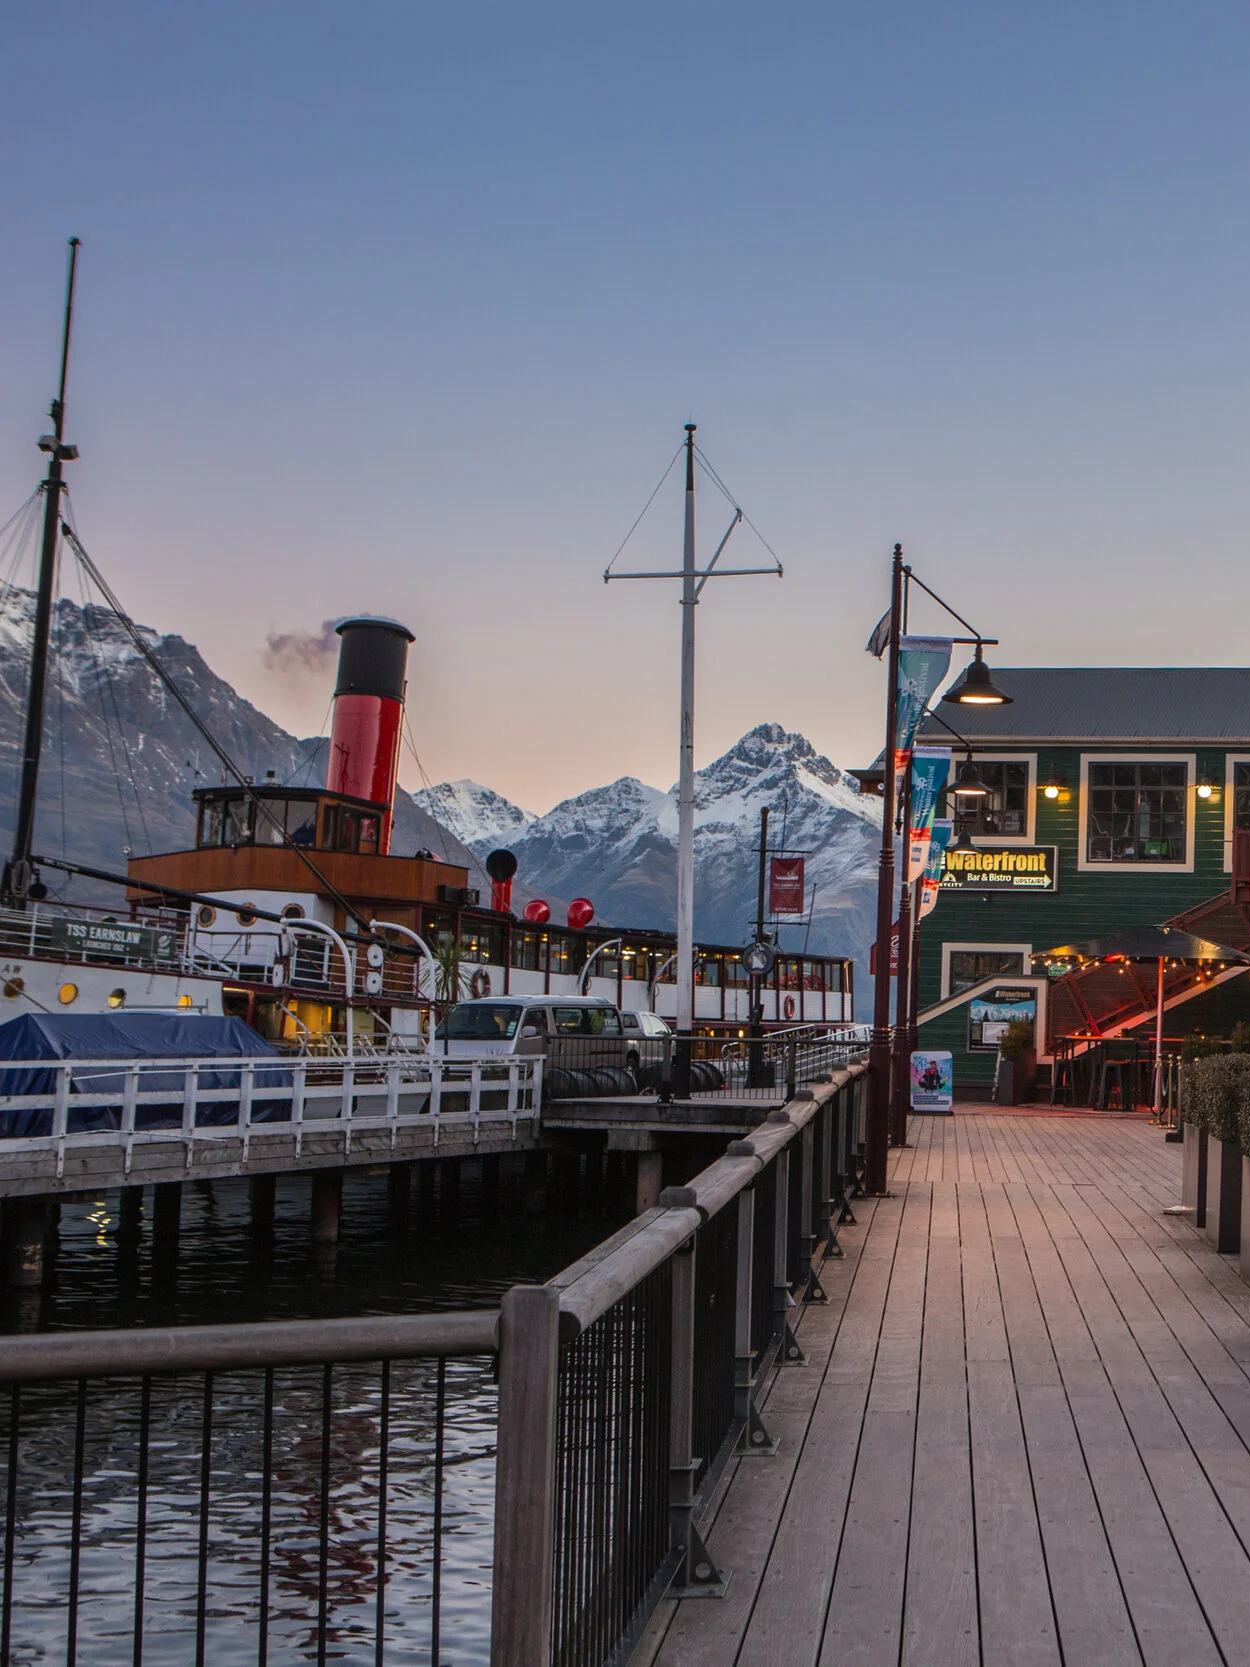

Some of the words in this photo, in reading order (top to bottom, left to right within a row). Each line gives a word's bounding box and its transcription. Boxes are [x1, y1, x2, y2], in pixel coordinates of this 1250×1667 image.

[946, 851, 1046, 871] Waterfront
[967, 873, 981, 881] Bar
[982, 873, 988, 881] &
[989, 873, 1012, 882] Bistro
[66, 923, 88, 938] TSS
[89, 926, 142, 944] EARNSLAW
